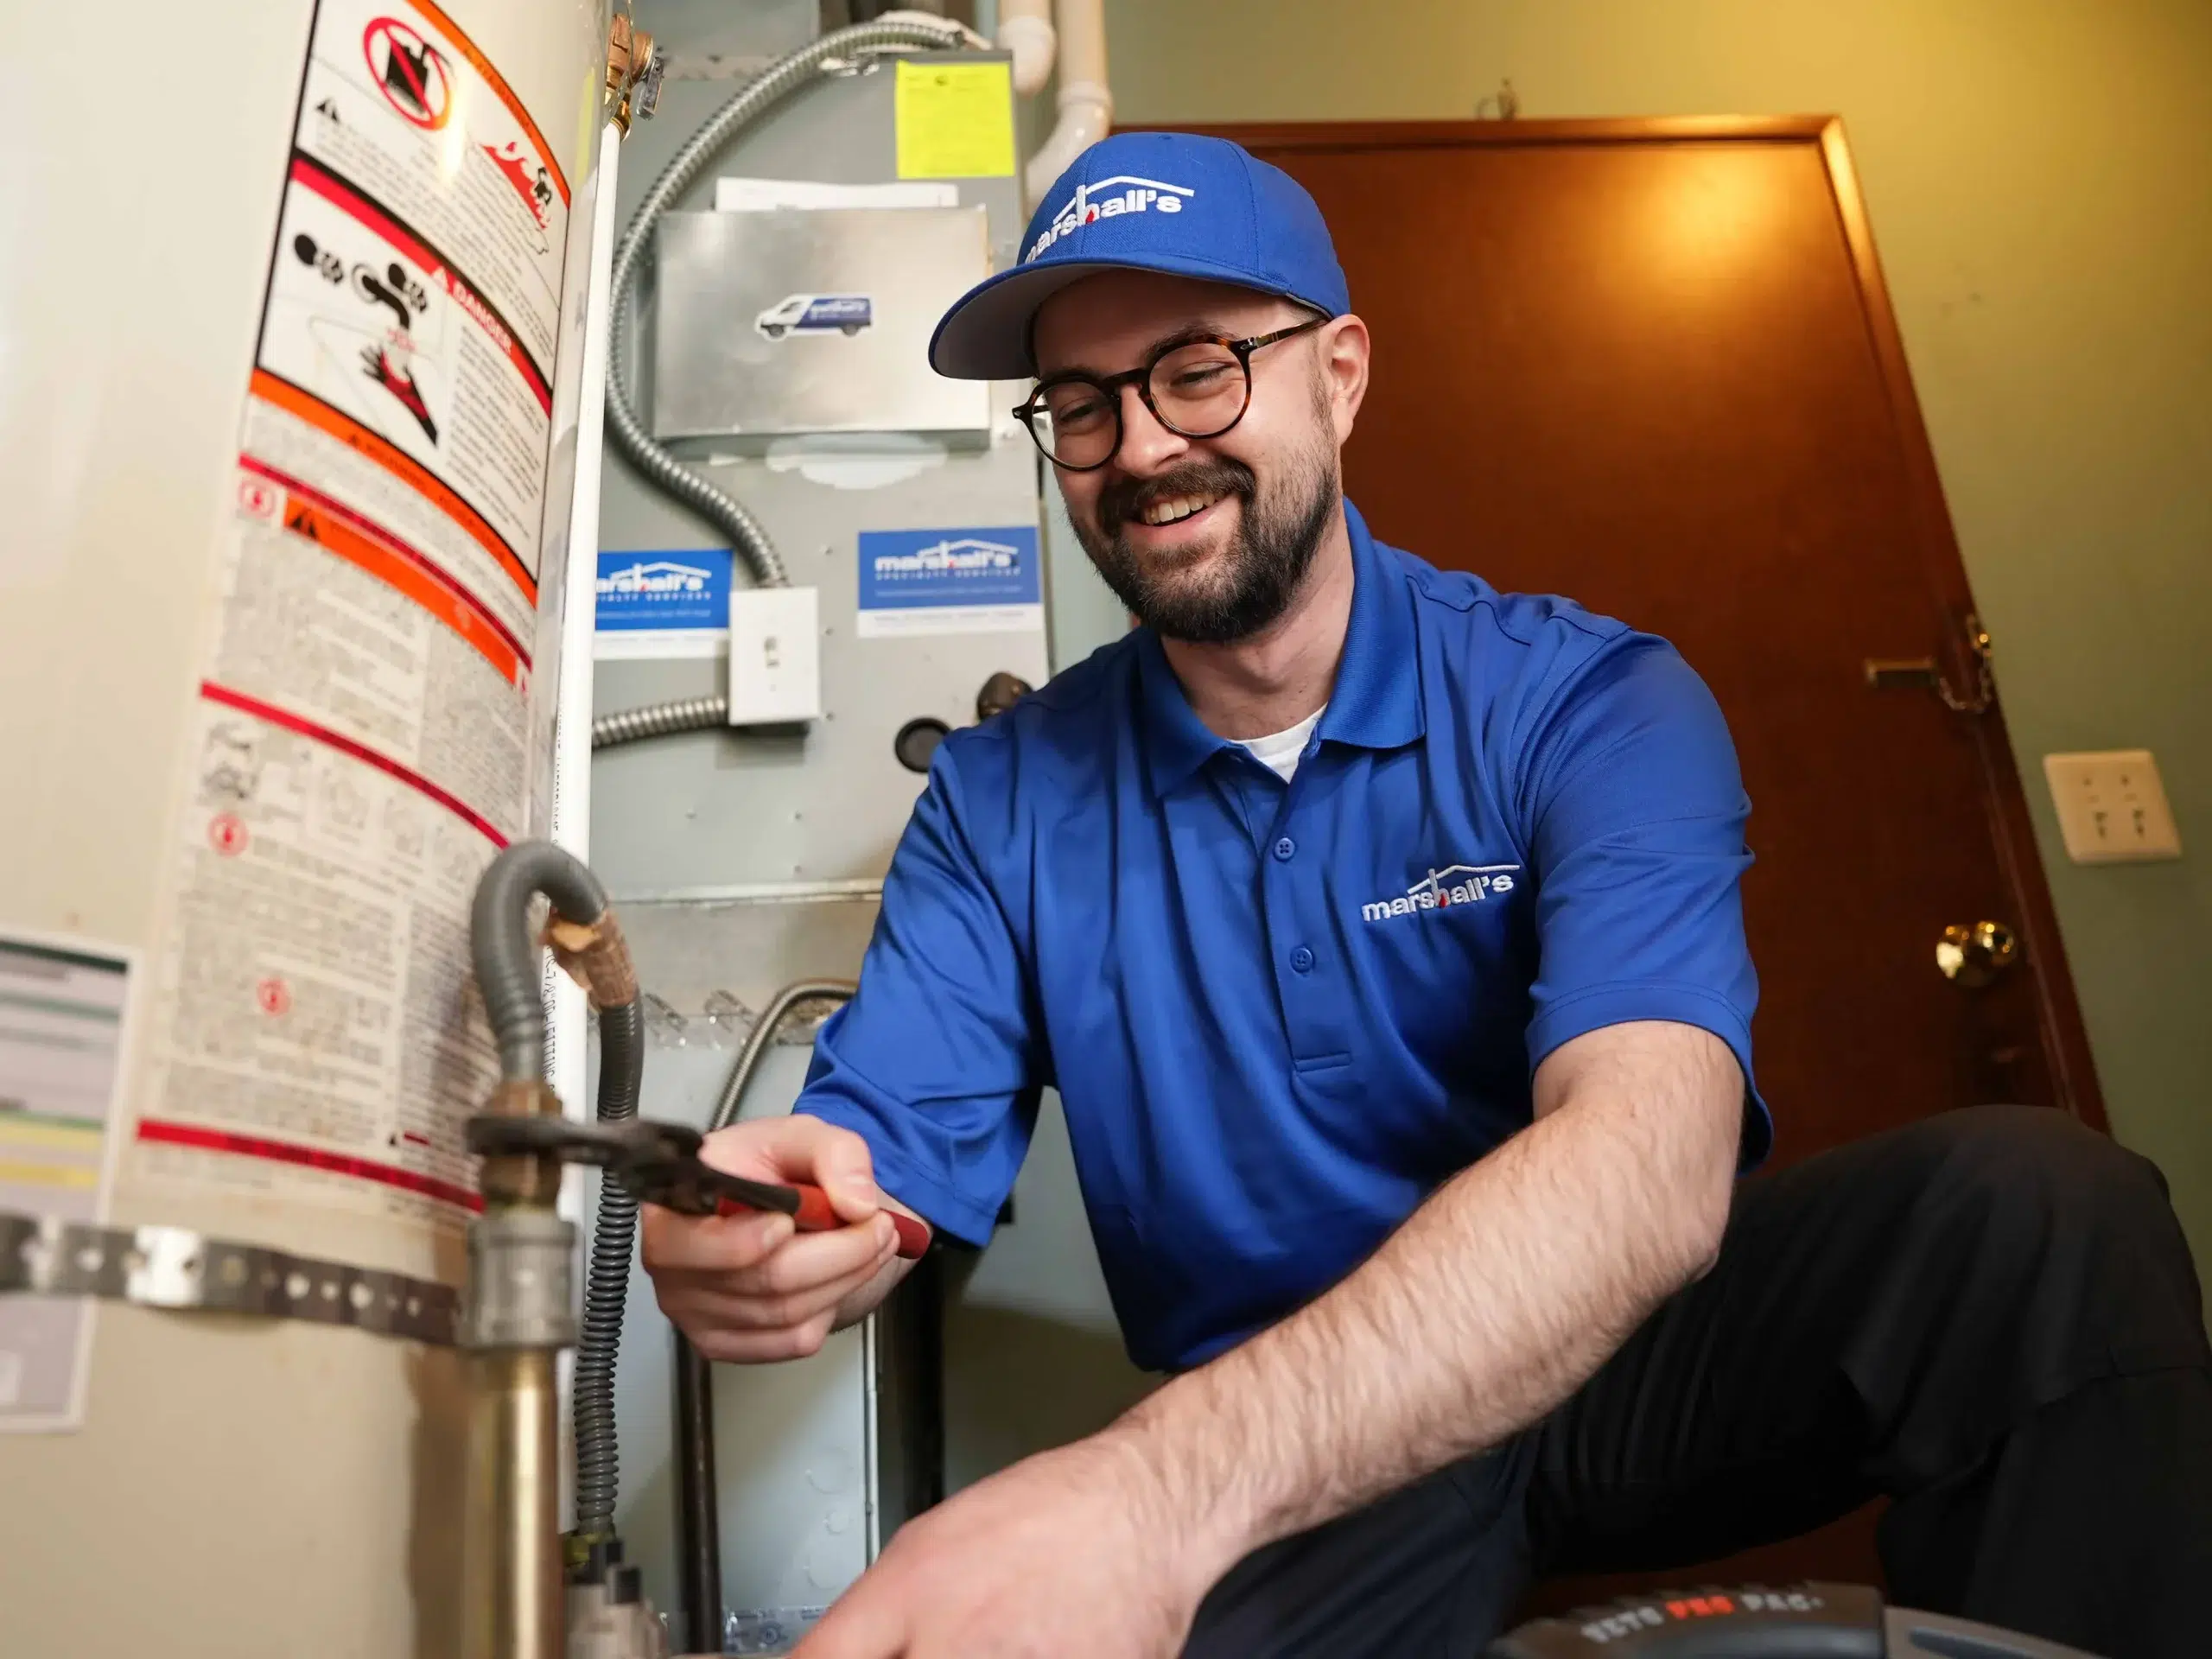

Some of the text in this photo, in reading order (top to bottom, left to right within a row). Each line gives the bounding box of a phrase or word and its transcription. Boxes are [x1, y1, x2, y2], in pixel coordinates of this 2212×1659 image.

[874, 539, 1011, 571] marshall's
[595, 563, 704, 594] arshall's
[1361, 868, 1514, 922] marshall's
